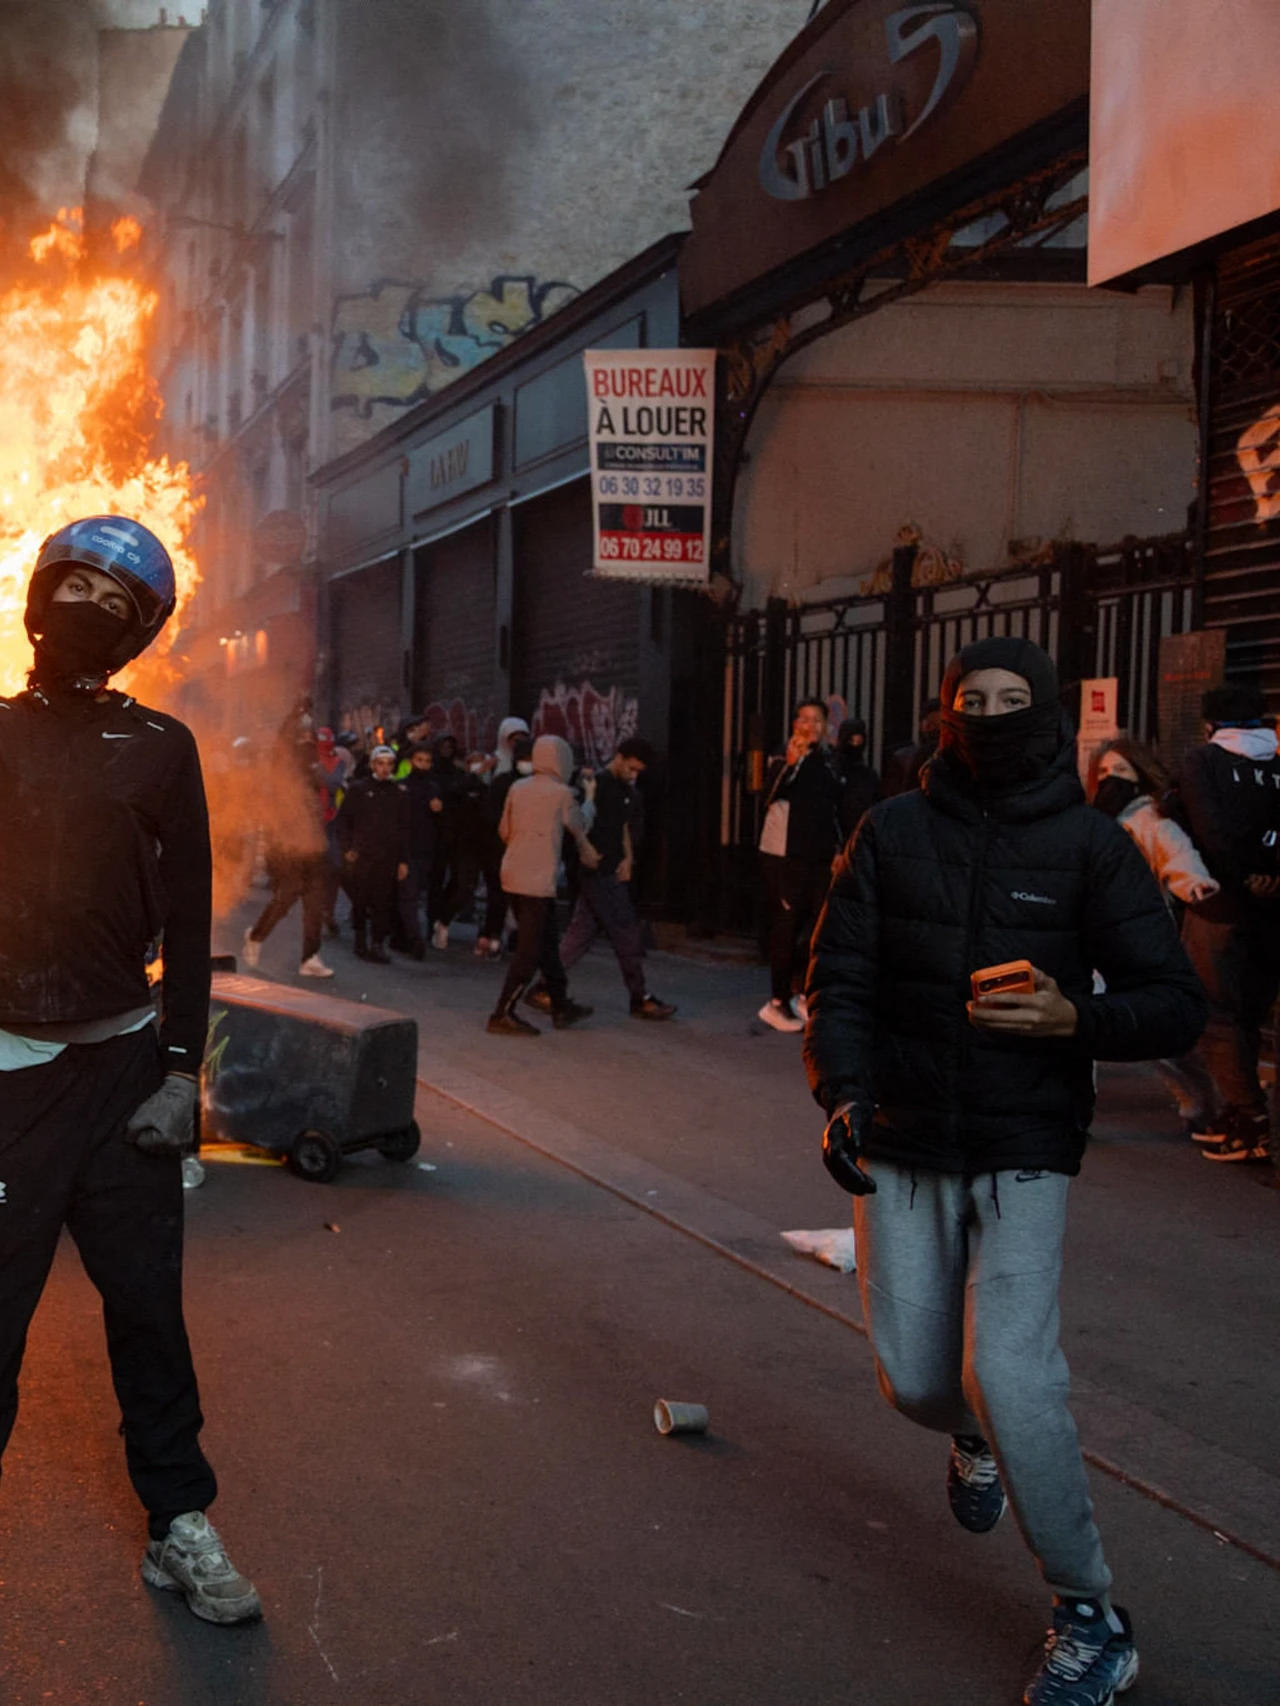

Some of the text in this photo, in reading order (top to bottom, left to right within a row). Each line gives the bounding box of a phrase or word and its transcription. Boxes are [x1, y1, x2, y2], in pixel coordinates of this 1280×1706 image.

[593, 368, 706, 397] BUREAUX
[596, 398, 706, 436] À LOUER
[600, 475, 705, 498] 06 30 32 19 35
[600, 536, 704, 560] 06 70 24 99 12
